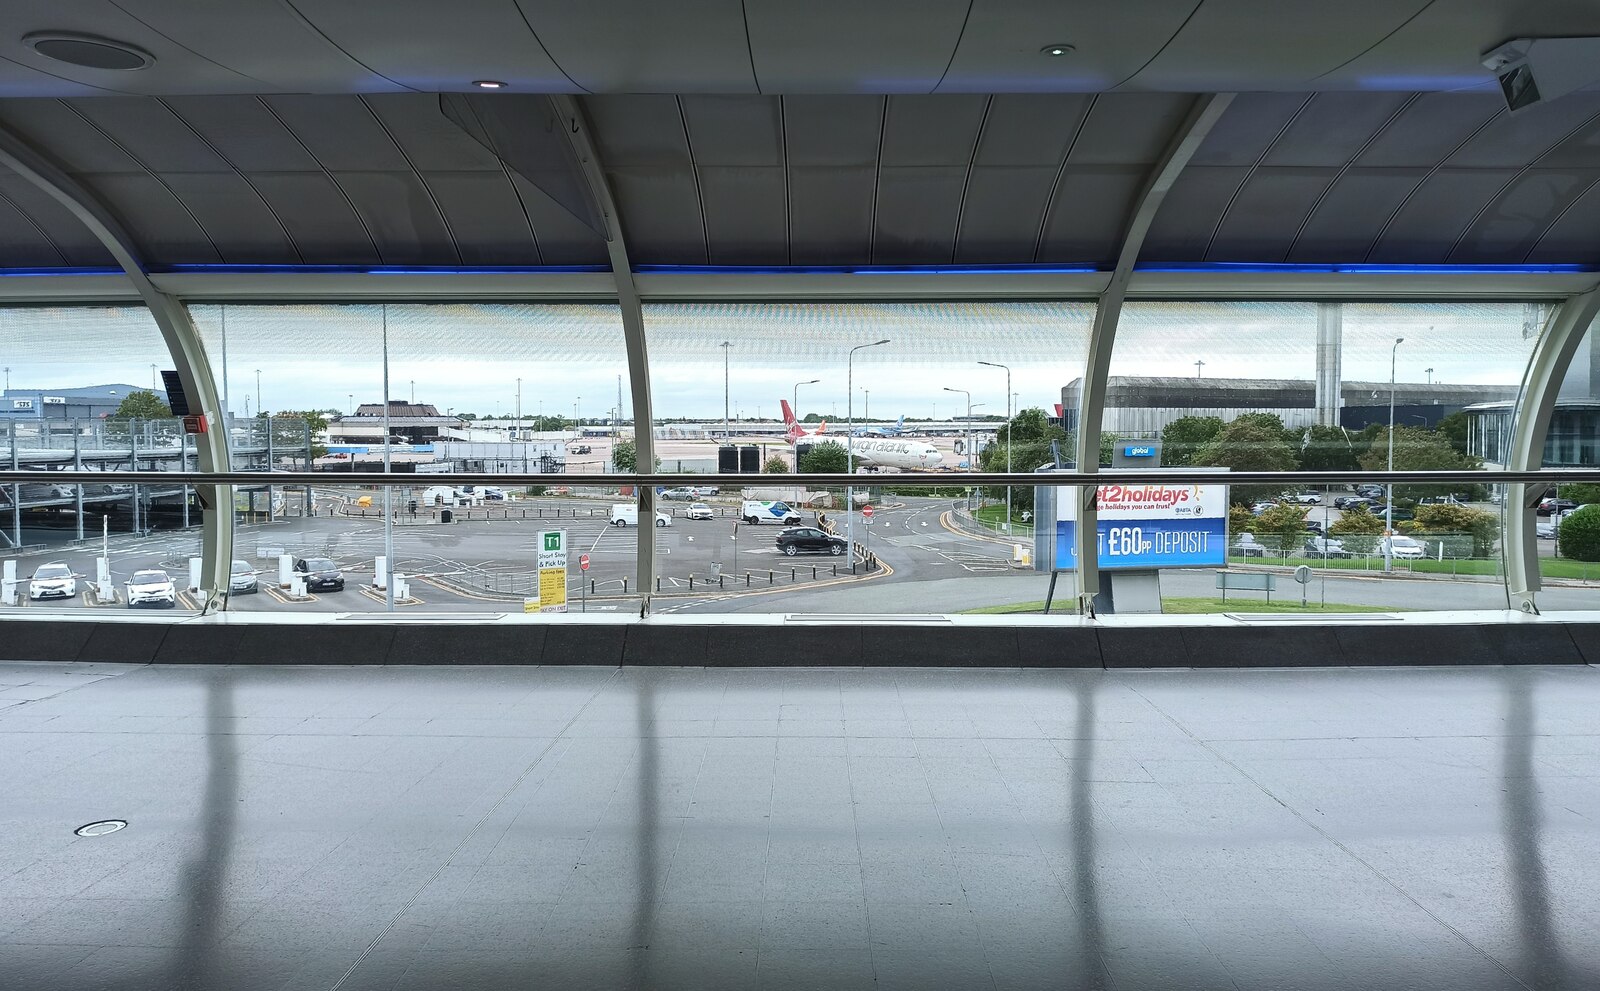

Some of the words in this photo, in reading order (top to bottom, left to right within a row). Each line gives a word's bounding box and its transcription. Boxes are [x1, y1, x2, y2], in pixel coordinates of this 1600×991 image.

[1131, 447, 1149, 456] global
[1096, 485, 1189, 506] et2holidays
[1105, 503, 1130, 511] holidays
[545, 536, 559, 548] T1
